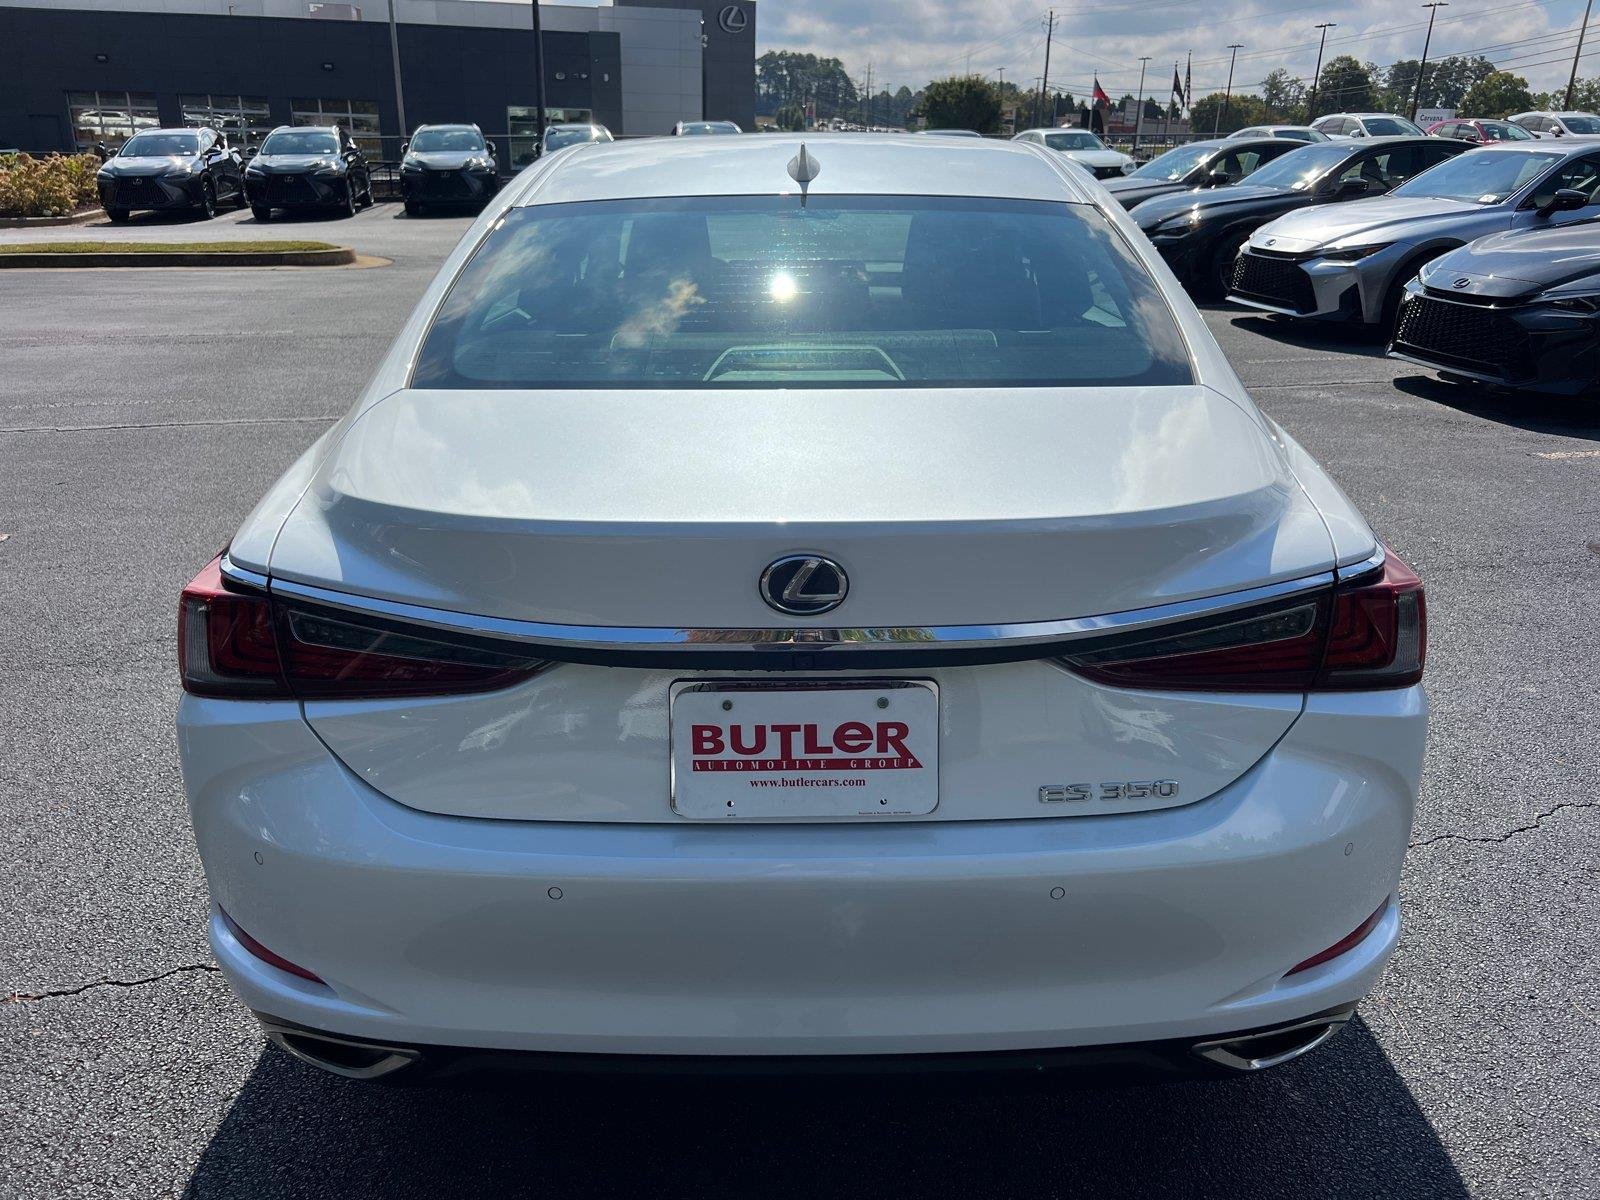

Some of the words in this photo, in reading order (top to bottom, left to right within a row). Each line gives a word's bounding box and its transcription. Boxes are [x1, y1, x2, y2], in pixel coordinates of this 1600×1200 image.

[693, 759, 828, 771] AUTOMOTIVE
[849, 757, 915, 769] GROUP
[749, 776, 867, 789] www.butlercars.com
[1038, 783, 1093, 804] ES
[1099, 779, 1179, 801] 350
